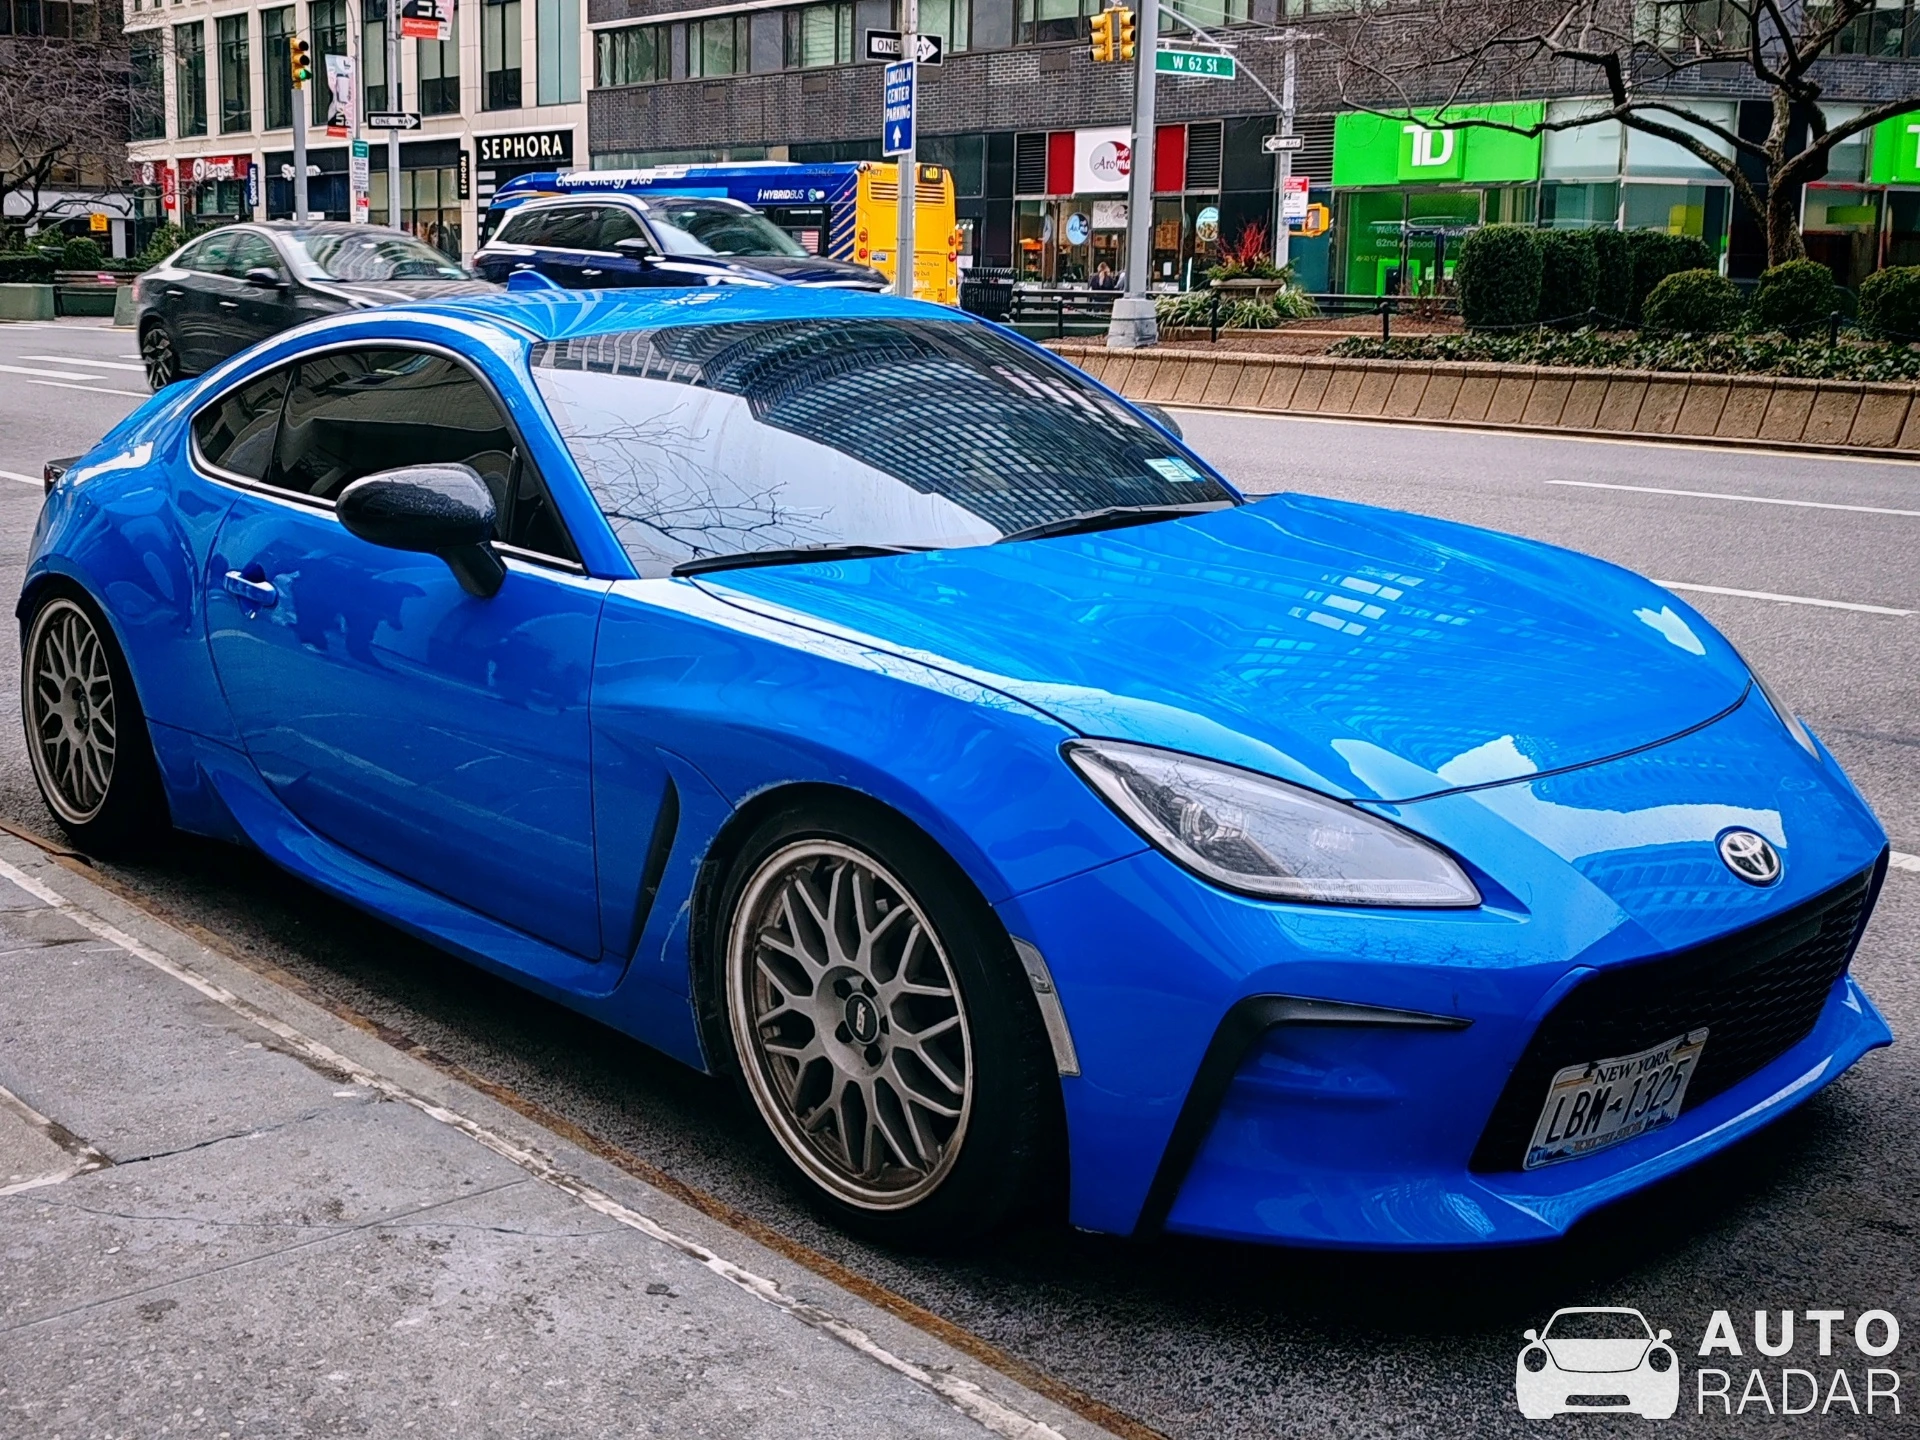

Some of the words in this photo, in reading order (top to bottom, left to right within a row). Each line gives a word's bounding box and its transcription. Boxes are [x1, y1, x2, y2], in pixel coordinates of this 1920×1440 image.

[877, 40, 899, 52] ONE
[917, 44, 931, 56] AY
[1173, 55, 1183, 69] W
[1188, 56, 1202, 71] 62
[1206, 58, 1218, 72] St
[887, 66, 912, 86] LINCOLN
[887, 86, 910, 104] CENTER
[375, 117, 390, 125] ONE
[397, 117, 413, 125] WAY
[886, 104, 911, 122] PARKING
[481, 134, 563, 160] SEPHORA
[1402, 124, 1454, 167] TD
[249, 167, 258, 205] Spectrum
[556, 172, 586, 187] clean
[1376, 239, 1398, 248] 62nd
[1593, 1062, 1637, 1085] NEW
[1639, 1048, 1673, 1074] YORK
